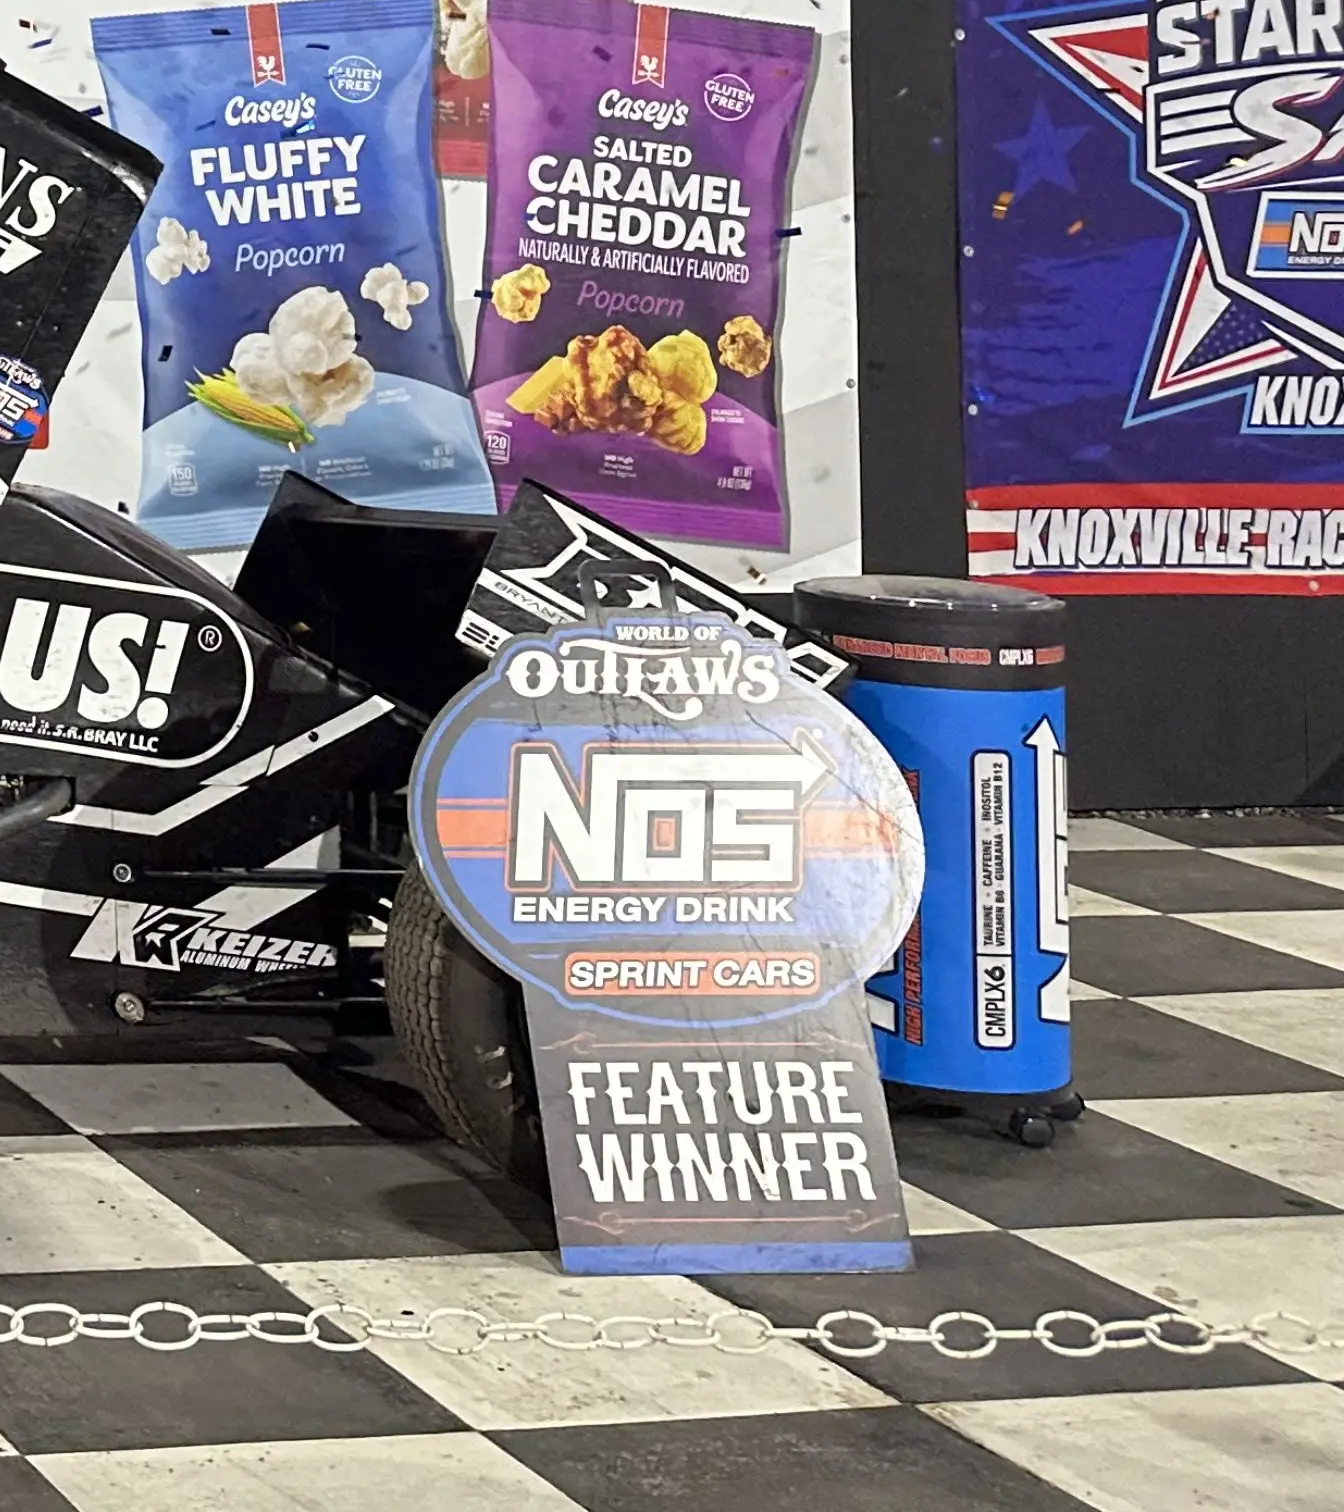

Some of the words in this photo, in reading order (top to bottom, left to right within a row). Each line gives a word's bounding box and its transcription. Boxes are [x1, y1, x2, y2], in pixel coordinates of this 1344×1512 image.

[327, 65, 382, 83] GLUTEN
[337, 78, 372, 92] FREE
[704, 78, 755, 104] GLUTEN
[224, 92, 316, 129] Casey's
[598, 88, 689, 131] Casey's
[711, 95, 745, 115] FREE
[190, 134, 367, 188] FLUFFY
[593, 135, 692, 168] SALTED
[205, 178, 362, 227] WHITE
[527, 154, 750, 218] CARAMEL
[526, 196, 746, 258] CHEDDAR
[235, 242, 345, 277] Popcorn
[518, 238, 589, 267] NATURALLY
[590, 249, 602, 266] &
[603, 249, 685, 277] ARTIFICIALLY
[686, 258, 749, 284] FLAVORED
[1287, 255, 1332, 265] ENERGY
[577, 280, 685, 319] Popcorn
[486, 434, 507, 449] 120
[171, 467, 192, 480] 150
[1014, 508, 1252, 568] KNOXVILLE
[615, 625, 690, 642] WORLD
[693, 625, 723, 641] OF
[84, 729, 128, 747] BRAY
[129, 733, 159, 753] LLC
[514, 740, 827, 881] NOS
[981, 776, 991, 821] INOSITOL
[982, 839, 993, 887] CAFFEINE
[513, 896, 664, 922] ENERGY
[676, 896, 794, 922] DRINK
[180, 949, 252, 971] ALUMINUM
[186, 927, 339, 967] KEIZER
[569, 960, 706, 988] SPRINT
[713, 958, 815, 987] CARS
[984, 966, 1007, 1038] CMPLX6
[567, 1062, 863, 1125] FEATURE
[575, 1132, 877, 1203] WINNER
